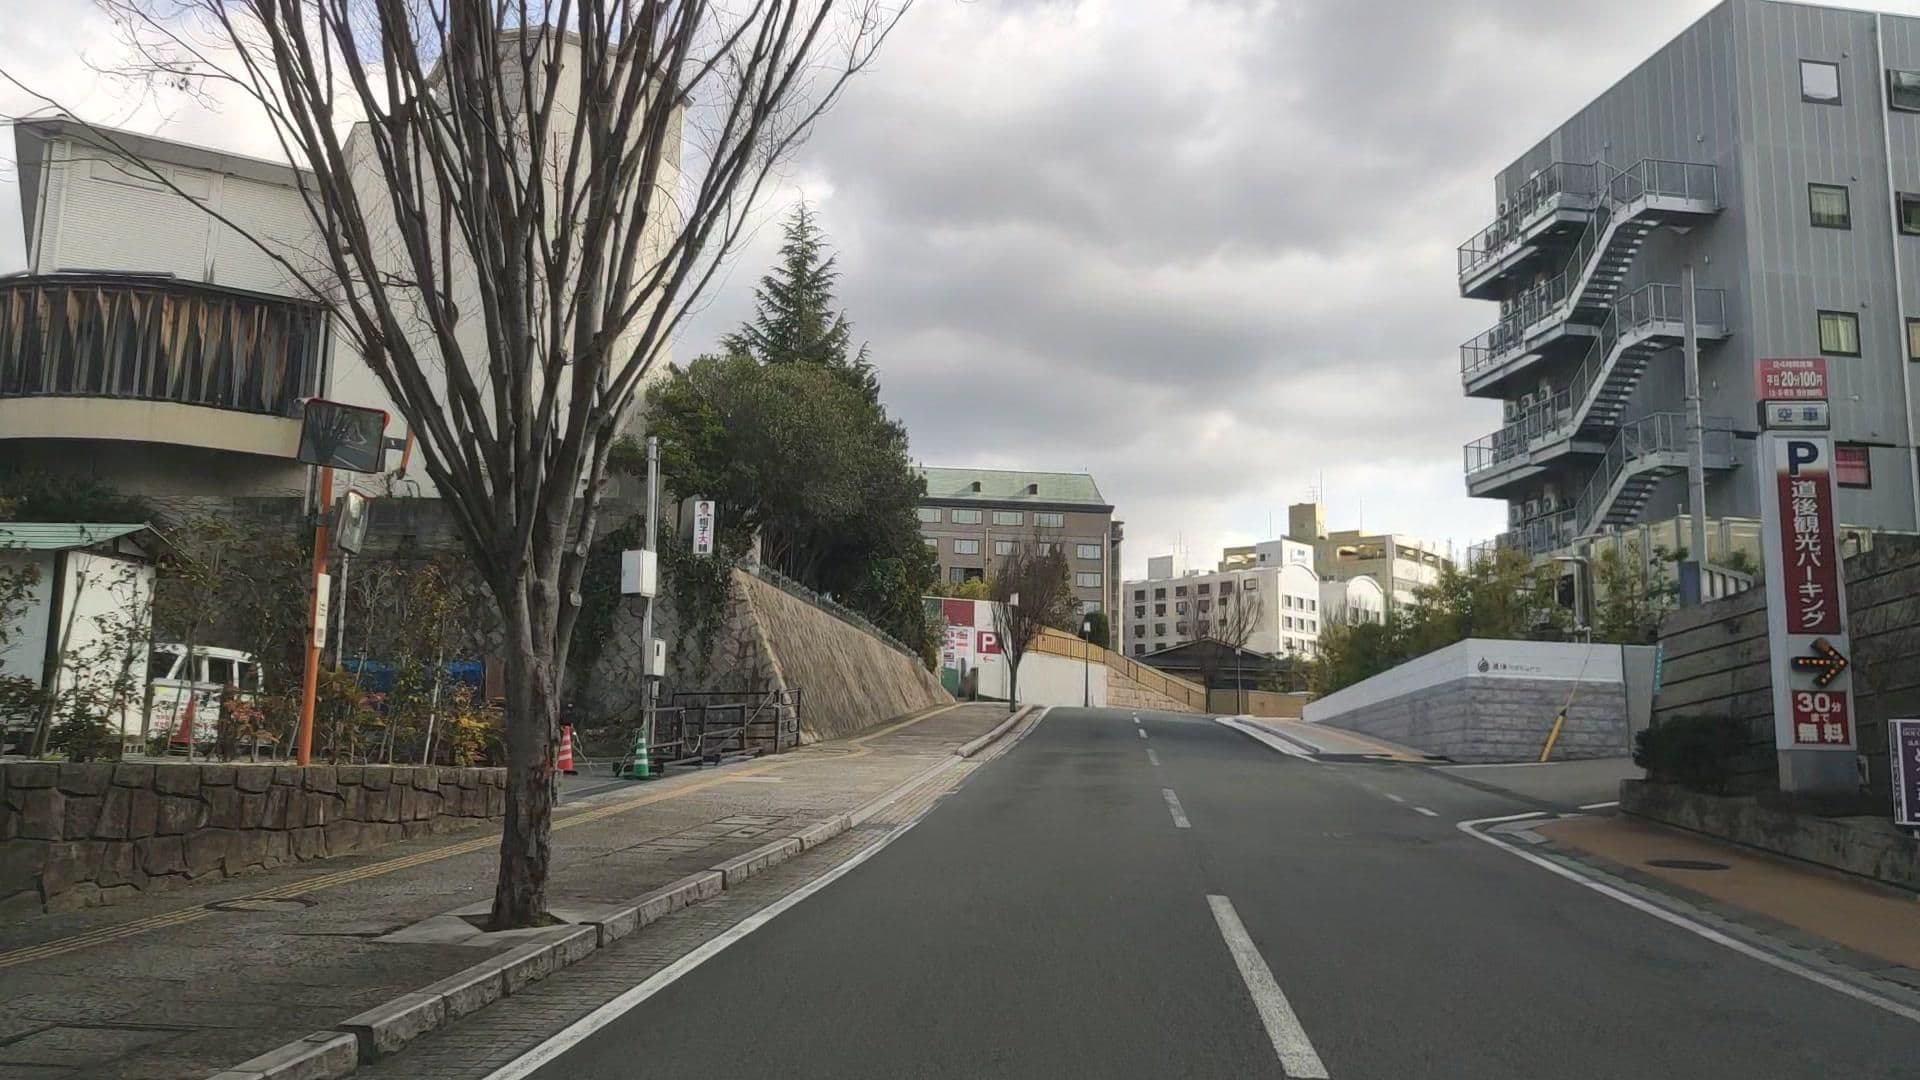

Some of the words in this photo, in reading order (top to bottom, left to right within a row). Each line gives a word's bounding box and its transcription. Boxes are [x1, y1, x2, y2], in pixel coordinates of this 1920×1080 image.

[1777, 407, 1819, 423] 空車
[1788, 440, 1819, 476] P
[1790, 480, 1826, 629] 道後観光パーキング
[982, 632, 996, 652] P
[1797, 692, 1841, 713] 30分
[1810, 712, 1830, 722] まで
[1797, 722, 1844, 743] 無料
